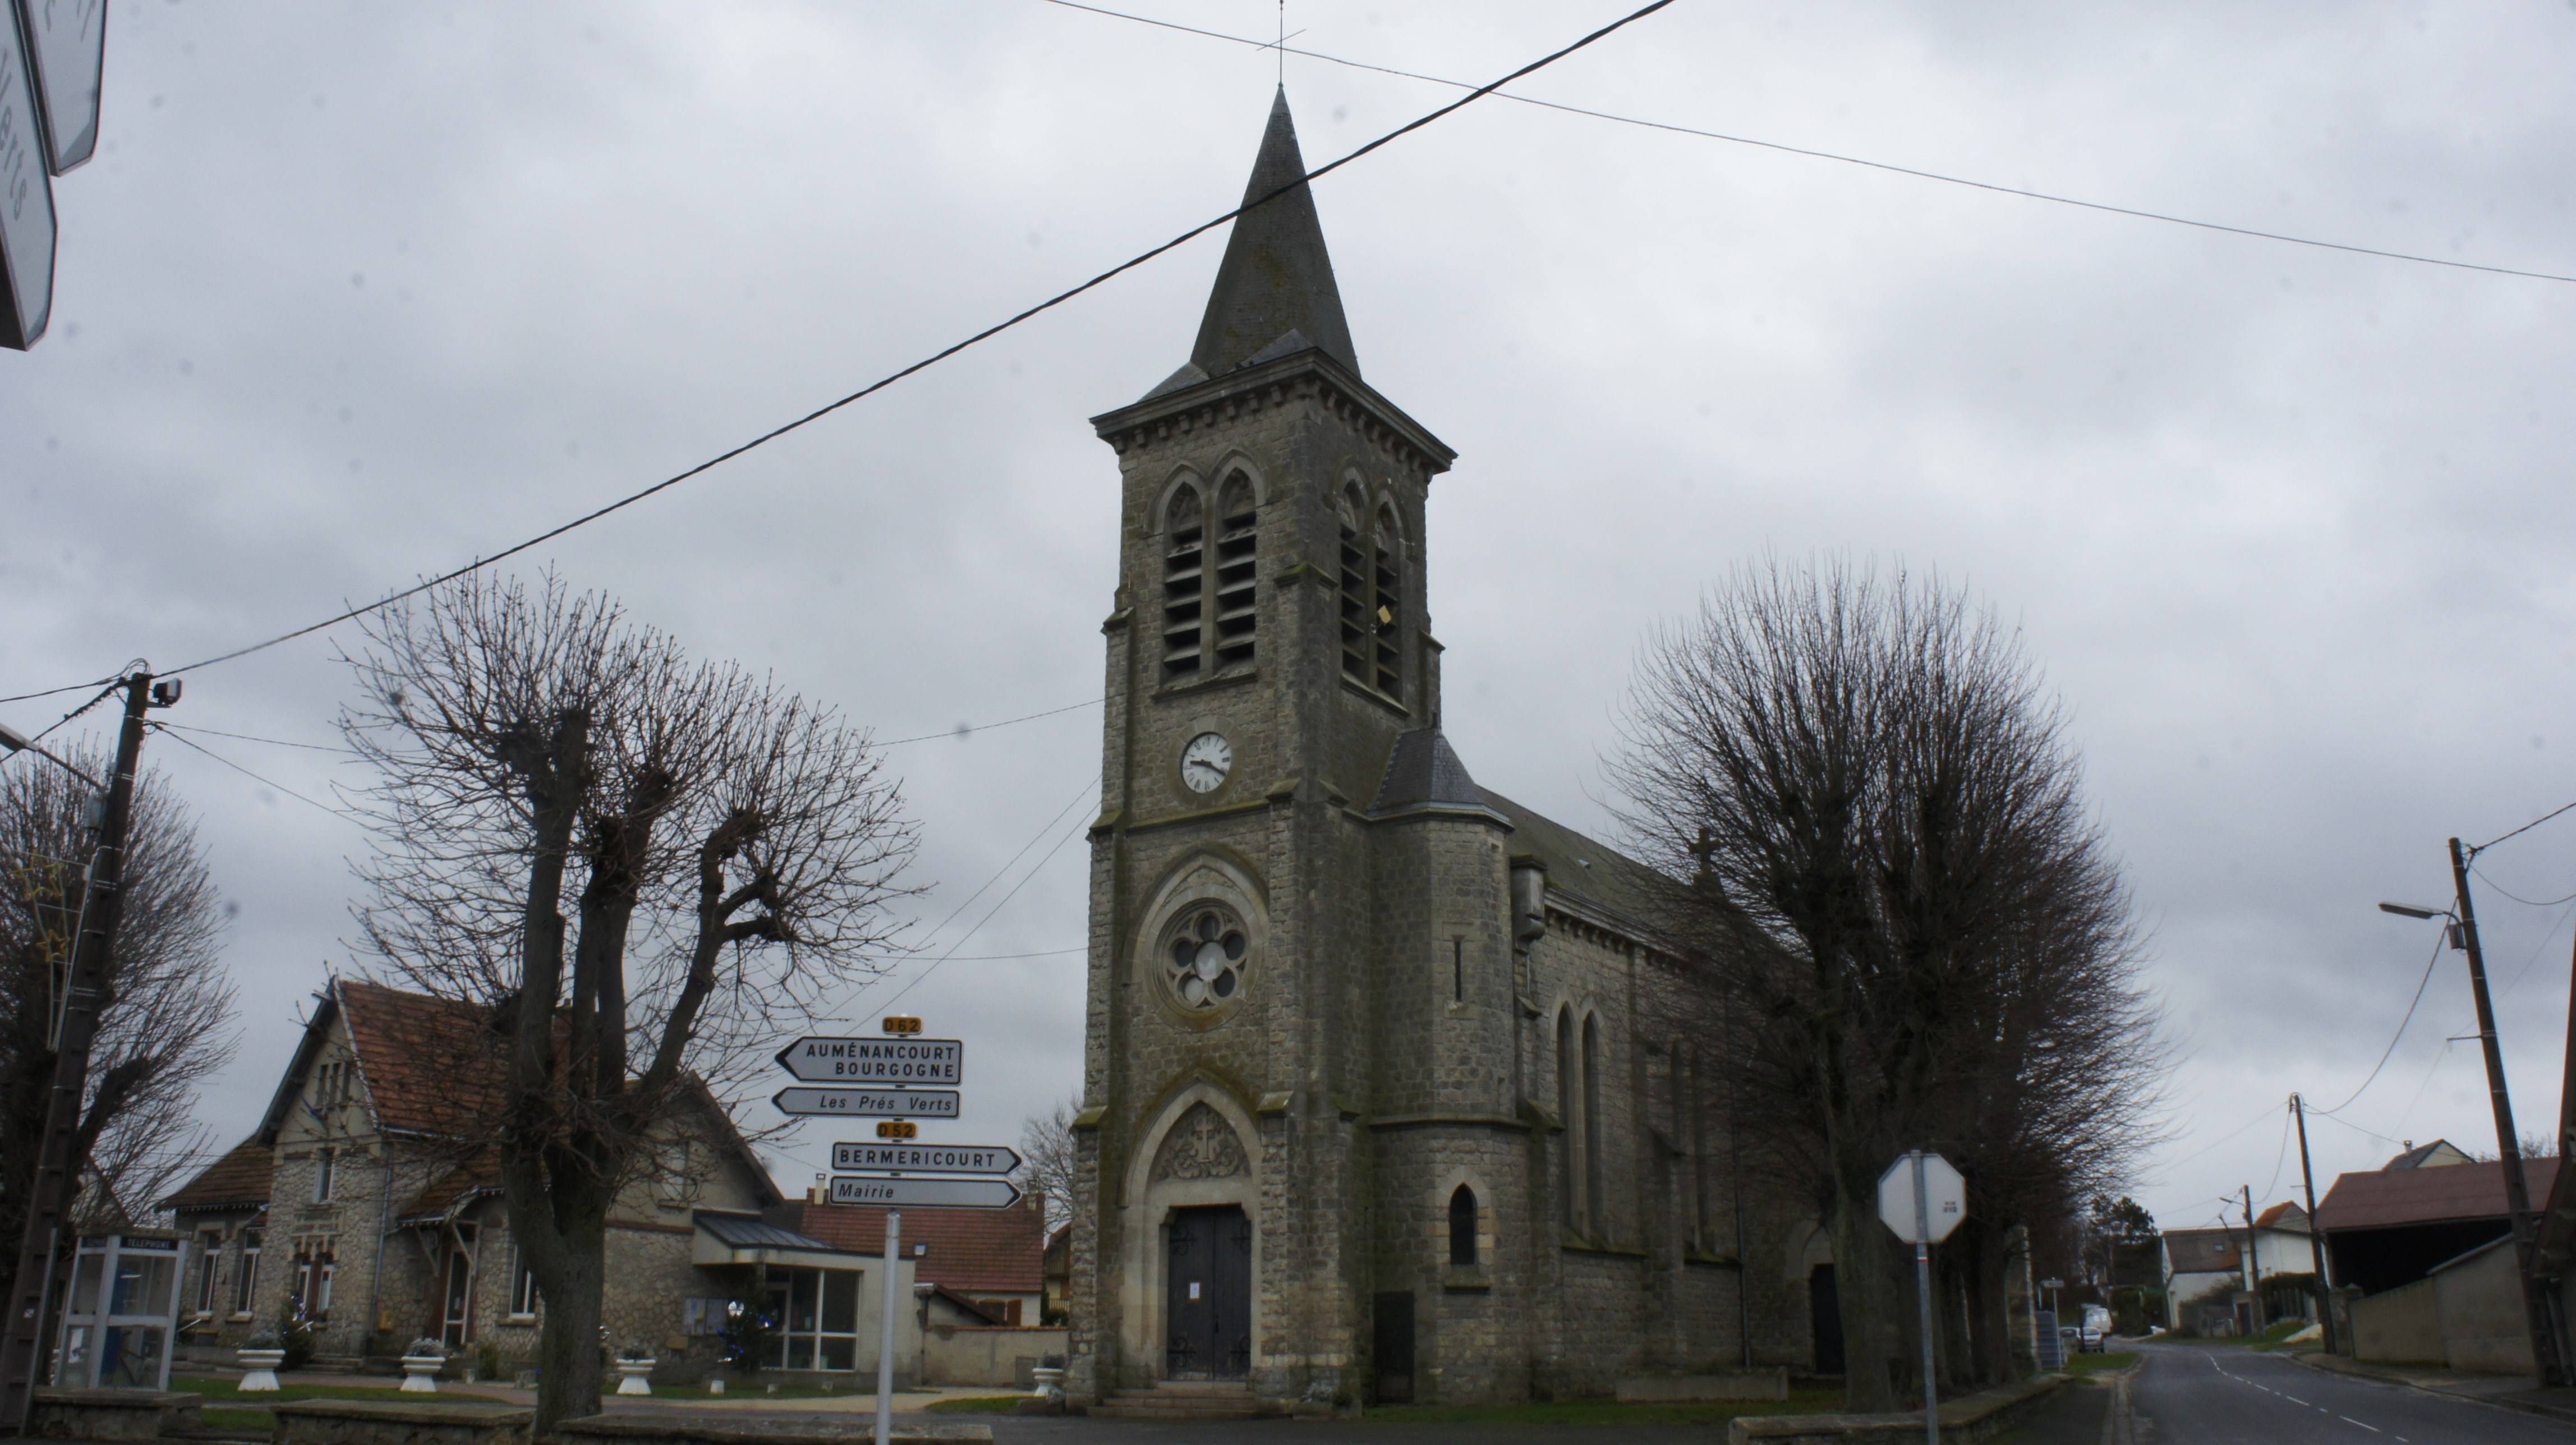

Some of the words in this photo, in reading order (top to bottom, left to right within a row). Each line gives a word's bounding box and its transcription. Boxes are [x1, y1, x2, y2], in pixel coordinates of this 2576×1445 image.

[806, 1042, 954, 1060] AUMÉNANCOURT
[835, 1061, 954, 1078] BOURGOGNE
[820, 1094, 847, 1109] Les
[859, 1095, 895, 1110] Prés
[909, 1097, 951, 1111] Verts
[840, 1150, 995, 1167] BERMERICOURT
[838, 1183, 894, 1199] Mairie
